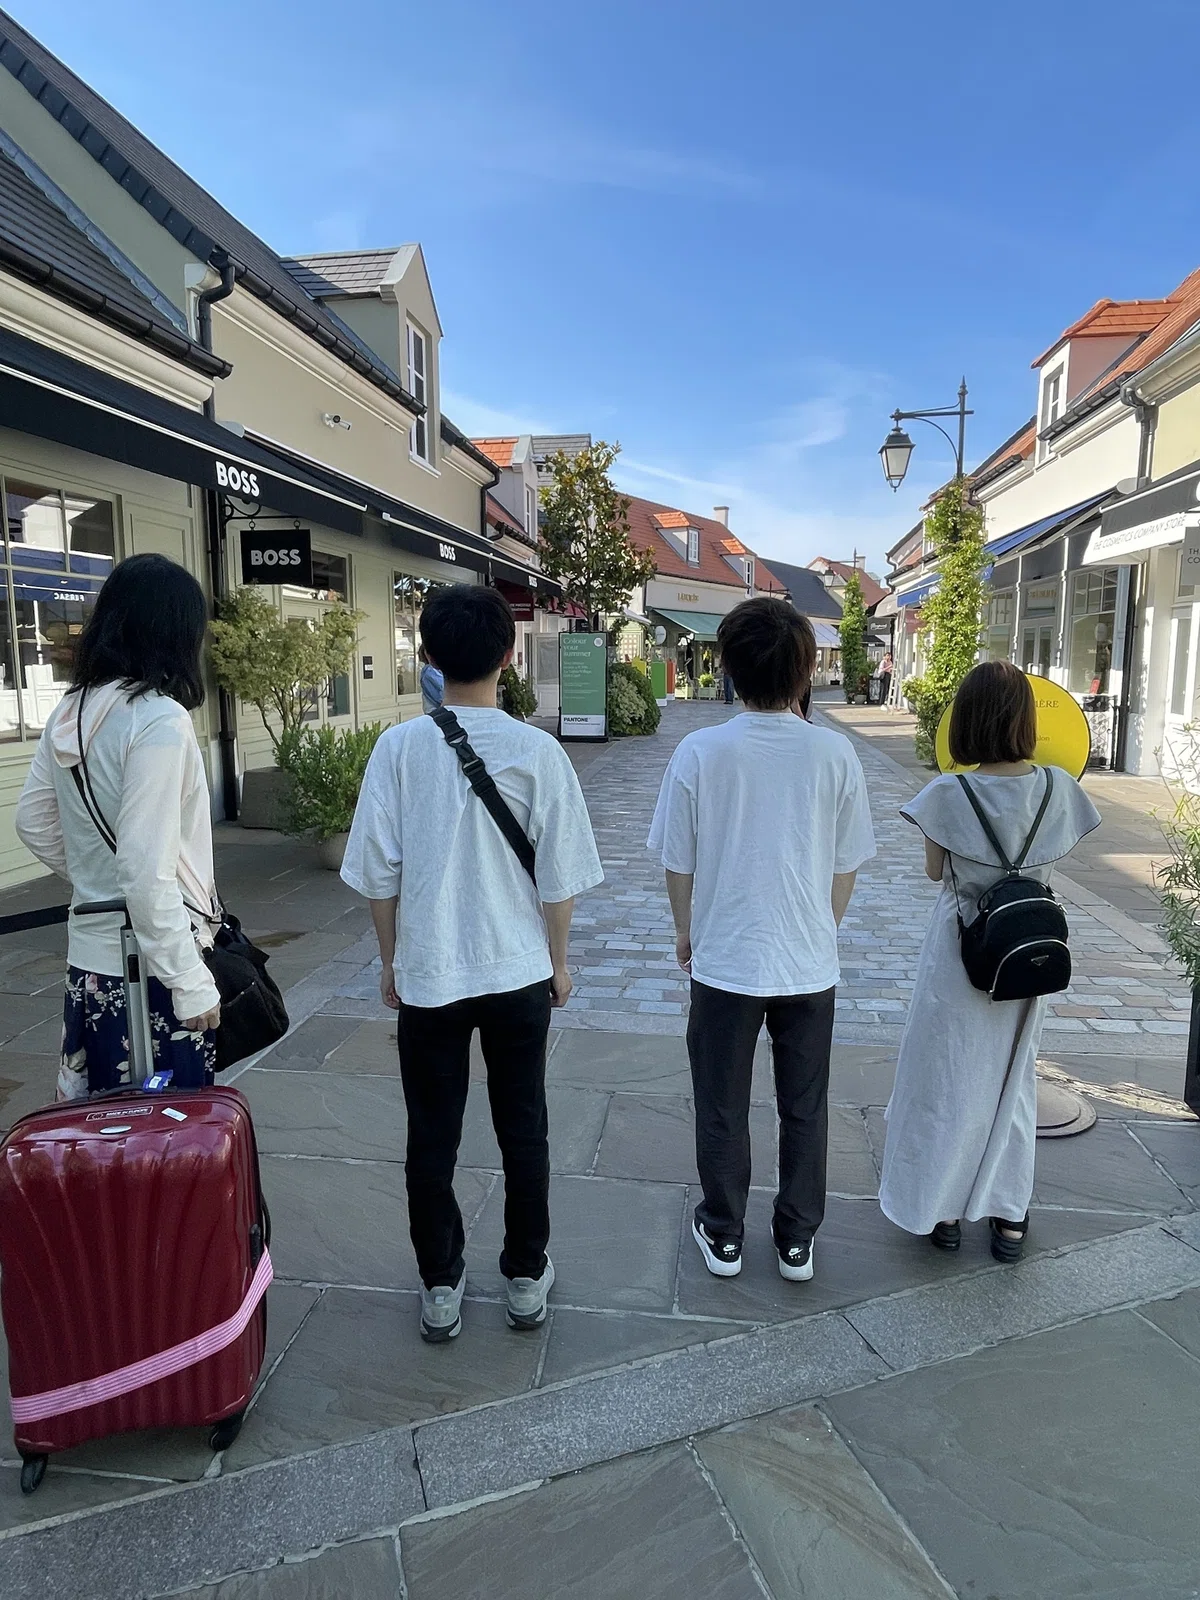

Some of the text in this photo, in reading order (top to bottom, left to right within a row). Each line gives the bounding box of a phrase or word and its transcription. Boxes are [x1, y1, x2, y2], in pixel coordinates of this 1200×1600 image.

[215, 461, 260, 497] BOSS
[1102, 532, 1133, 549] COSMETICS
[1133, 522, 1164, 540] COMPANY
[1164, 515, 1187, 531] STORE
[251, 549, 301, 566] BOSS
[440, 543, 456, 561] BOSS
